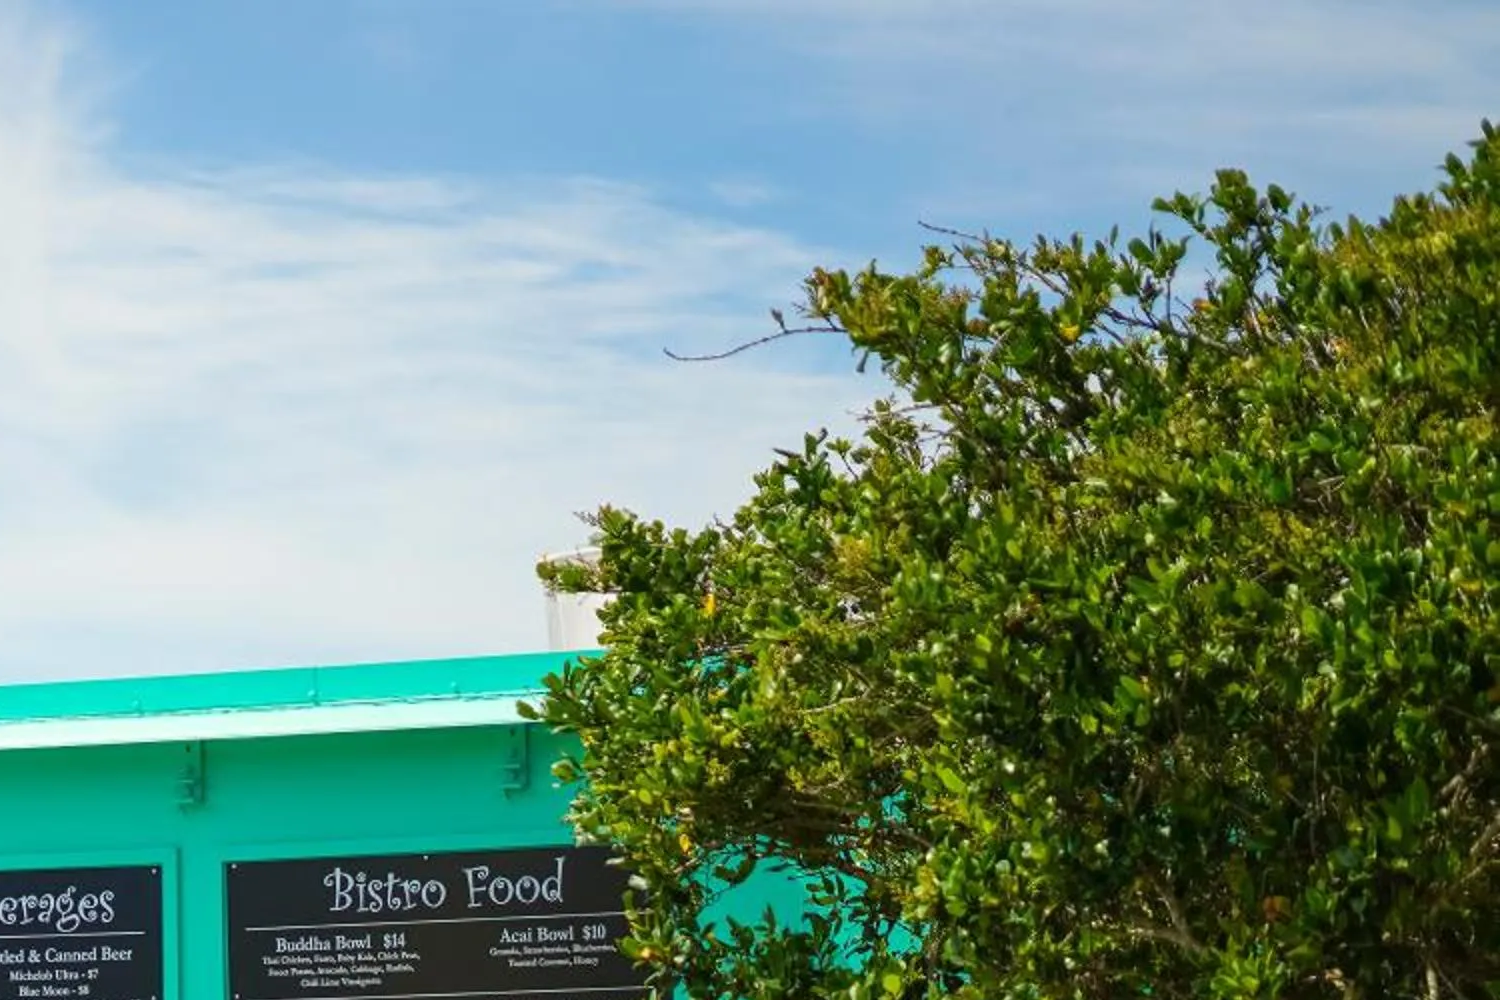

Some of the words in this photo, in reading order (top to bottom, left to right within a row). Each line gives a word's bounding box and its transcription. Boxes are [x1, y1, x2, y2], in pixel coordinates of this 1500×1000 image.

[324, 867, 447, 913] Bistro
[462, 856, 566, 909] Food
[276, 936, 331, 952] Buddha
[336, 934, 371, 950] Bowl
[383, 933, 405, 948] $14
[500, 927, 532, 943] Acai
[537, 926, 574, 942] Bowl
[582, 924, 606, 940] $10
[28, 949, 40, 962] &
[45, 947, 96, 963] Canned
[101, 946, 132, 961] Beer
[9, 970, 52, 981] Michelob
[55, 970, 79, 980] Ultra
[88, 969, 99, 979] $7
[19, 986, 40, 996] Blue
[43, 986, 70, 996] Moon
